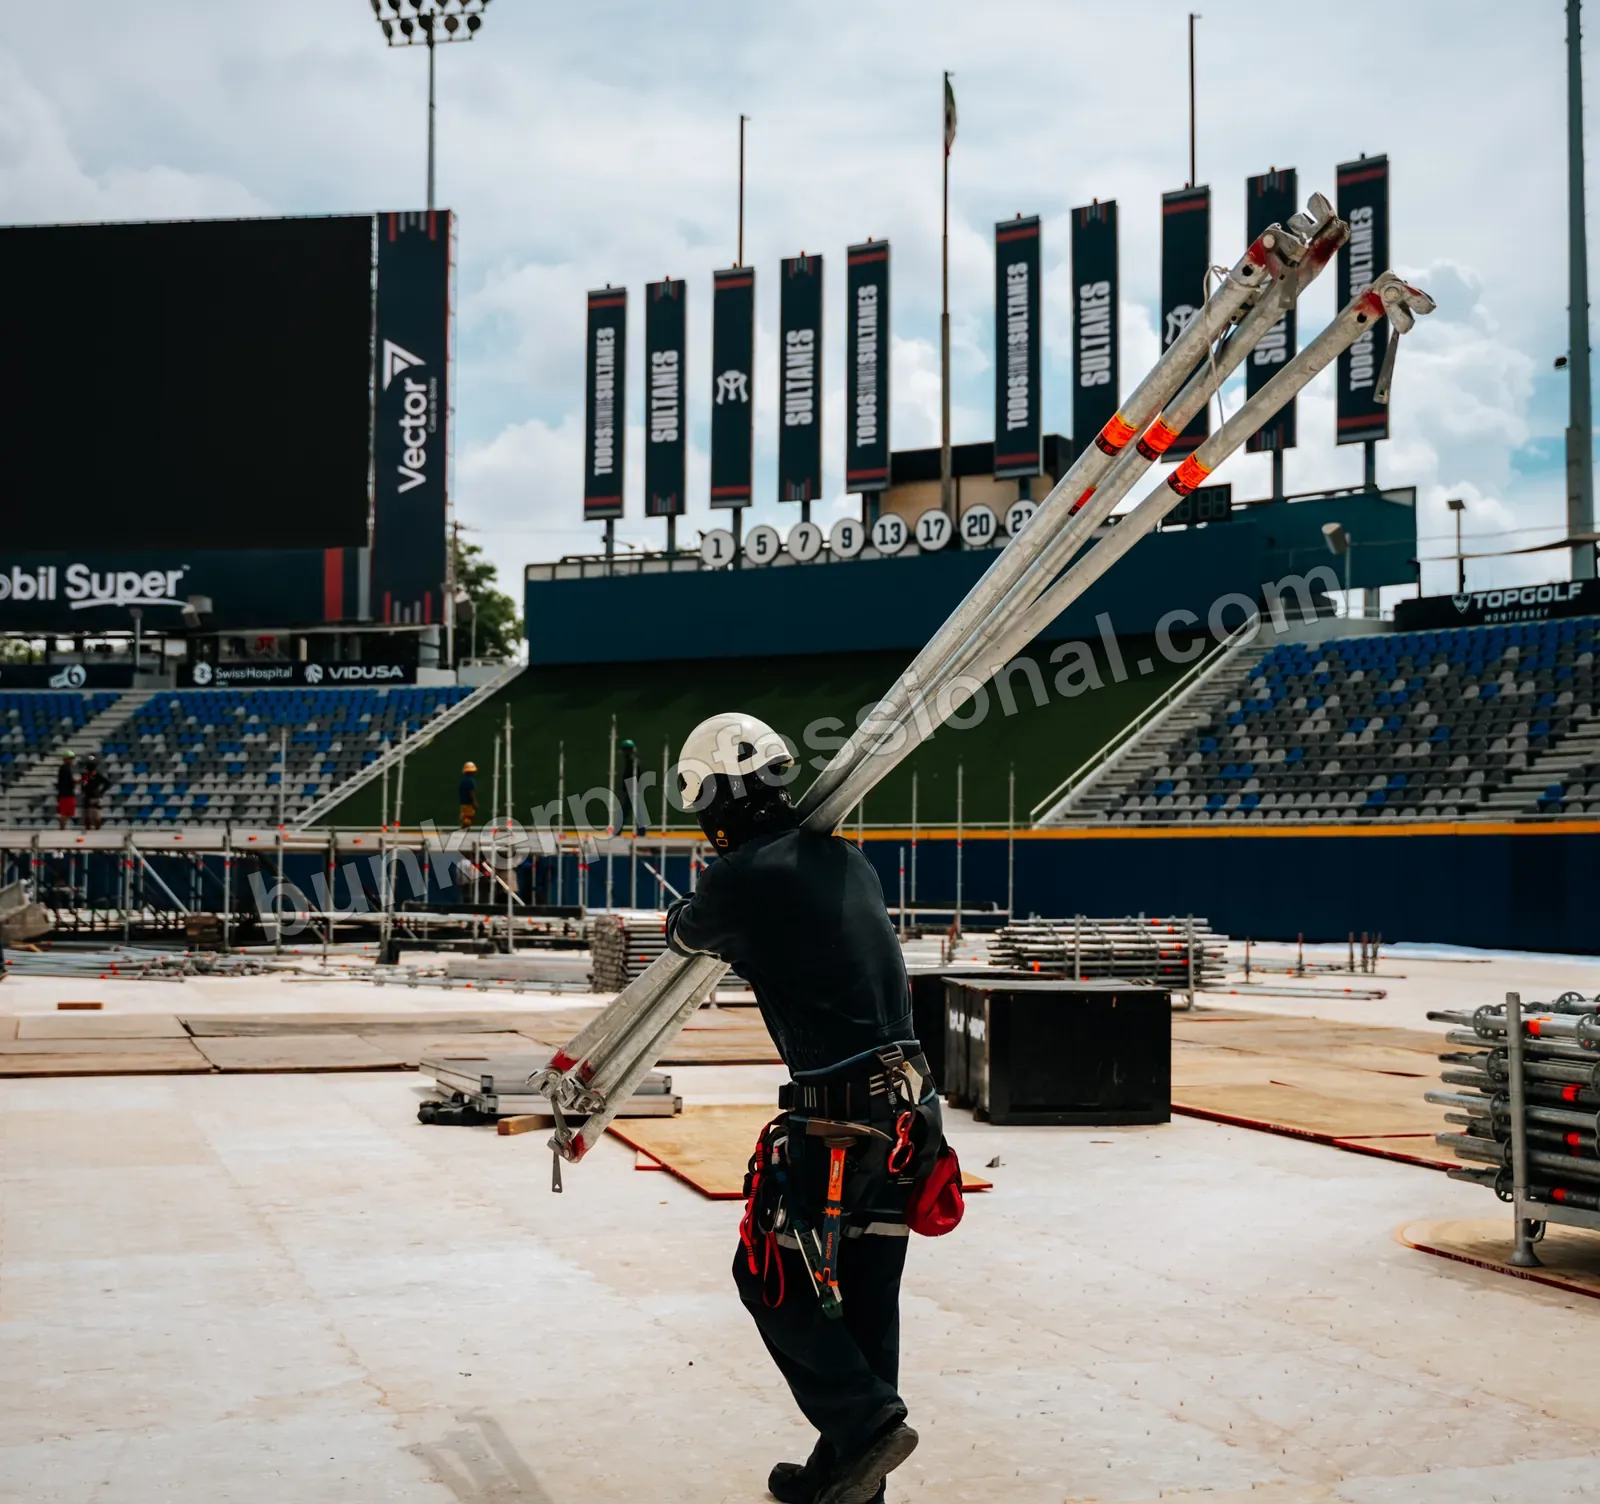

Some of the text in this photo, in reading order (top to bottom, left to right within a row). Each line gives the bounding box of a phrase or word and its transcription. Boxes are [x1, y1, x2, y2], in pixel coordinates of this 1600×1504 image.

[1007, 262, 1029, 344] SULTANES
[857, 284, 878, 364] SULTANES
[1080, 280, 1111, 388] SULTANES
[596, 327, 615, 400] SULTANES
[786, 328, 814, 426] SULTANES
[651, 350, 678, 443] SULTANES
[397, 378, 428, 494] Vector
[841, 527, 853, 549] 9
[876, 523, 900, 546] 13
[922, 519, 945, 542] 17
[967, 514, 990, 537] 20
[713, 538, 723, 560] 1
[756, 534, 767, 556] 5
[799, 531, 810, 552] 7
[64, 563, 184, 607] Super
[1473, 583, 1583, 610] TOPGOLF
[1484, 608, 1550, 623] MONTERREY
[328, 665, 404, 680] VIDUSA
